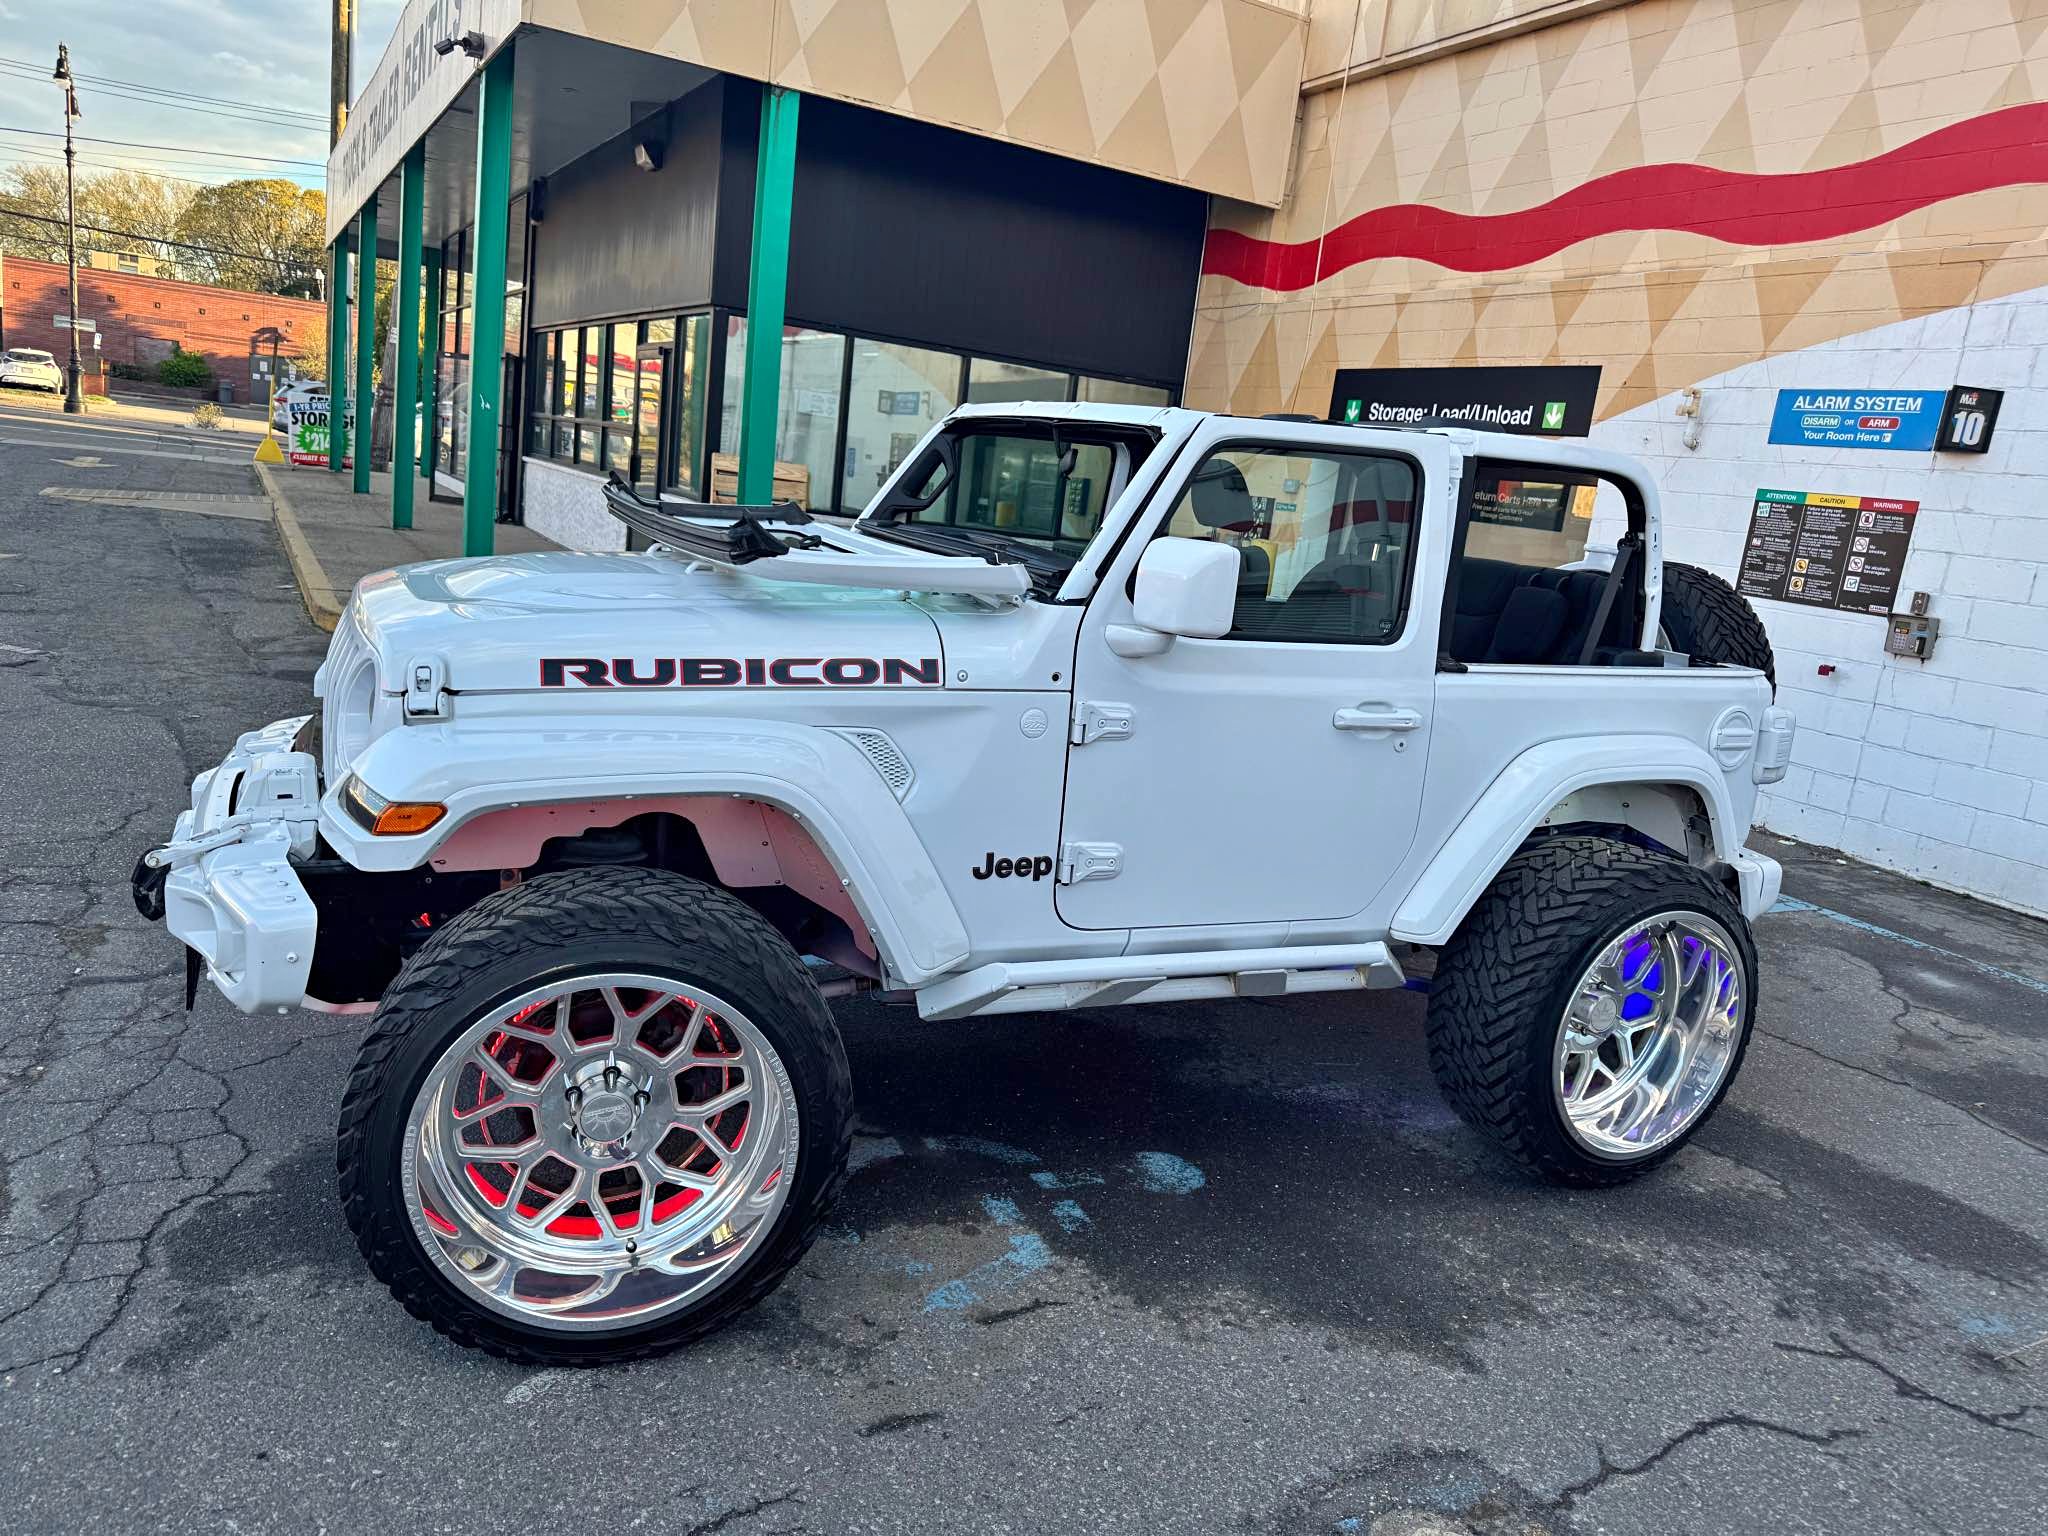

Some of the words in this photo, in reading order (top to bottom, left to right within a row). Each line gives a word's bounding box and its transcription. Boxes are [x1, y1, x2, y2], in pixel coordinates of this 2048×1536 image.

[368, 63, 399, 163] TRAILER
[294, 402, 310, 411] 1-YR
[311, 402, 330, 411] PRIC
[1793, 396, 1850, 411] ALARM
[1853, 396, 1923, 412] SYSTEM
[1432, 402, 1534, 426] Load/Unload
[1803, 416, 1839, 427] DISARM
[1867, 418, 1891, 429] ARM
[1952, 411, 1986, 446] 10
[1804, 431, 1824, 441] Your
[1825, 431, 1854, 442] Room
[1857, 433, 1880, 443] Here
[1474, 491, 1496, 503] eturn
[1766, 493, 1797, 501] ATTENTION
[1819, 497, 1846, 505] CAUTION
[1873, 501, 1904, 510] WARNING
[539, 657, 941, 688] RUBICON
[972, 852, 1054, 881] Jeep
[784, 1117, 799, 1186] FORGED
[402, 1124, 418, 1199] FORGED
